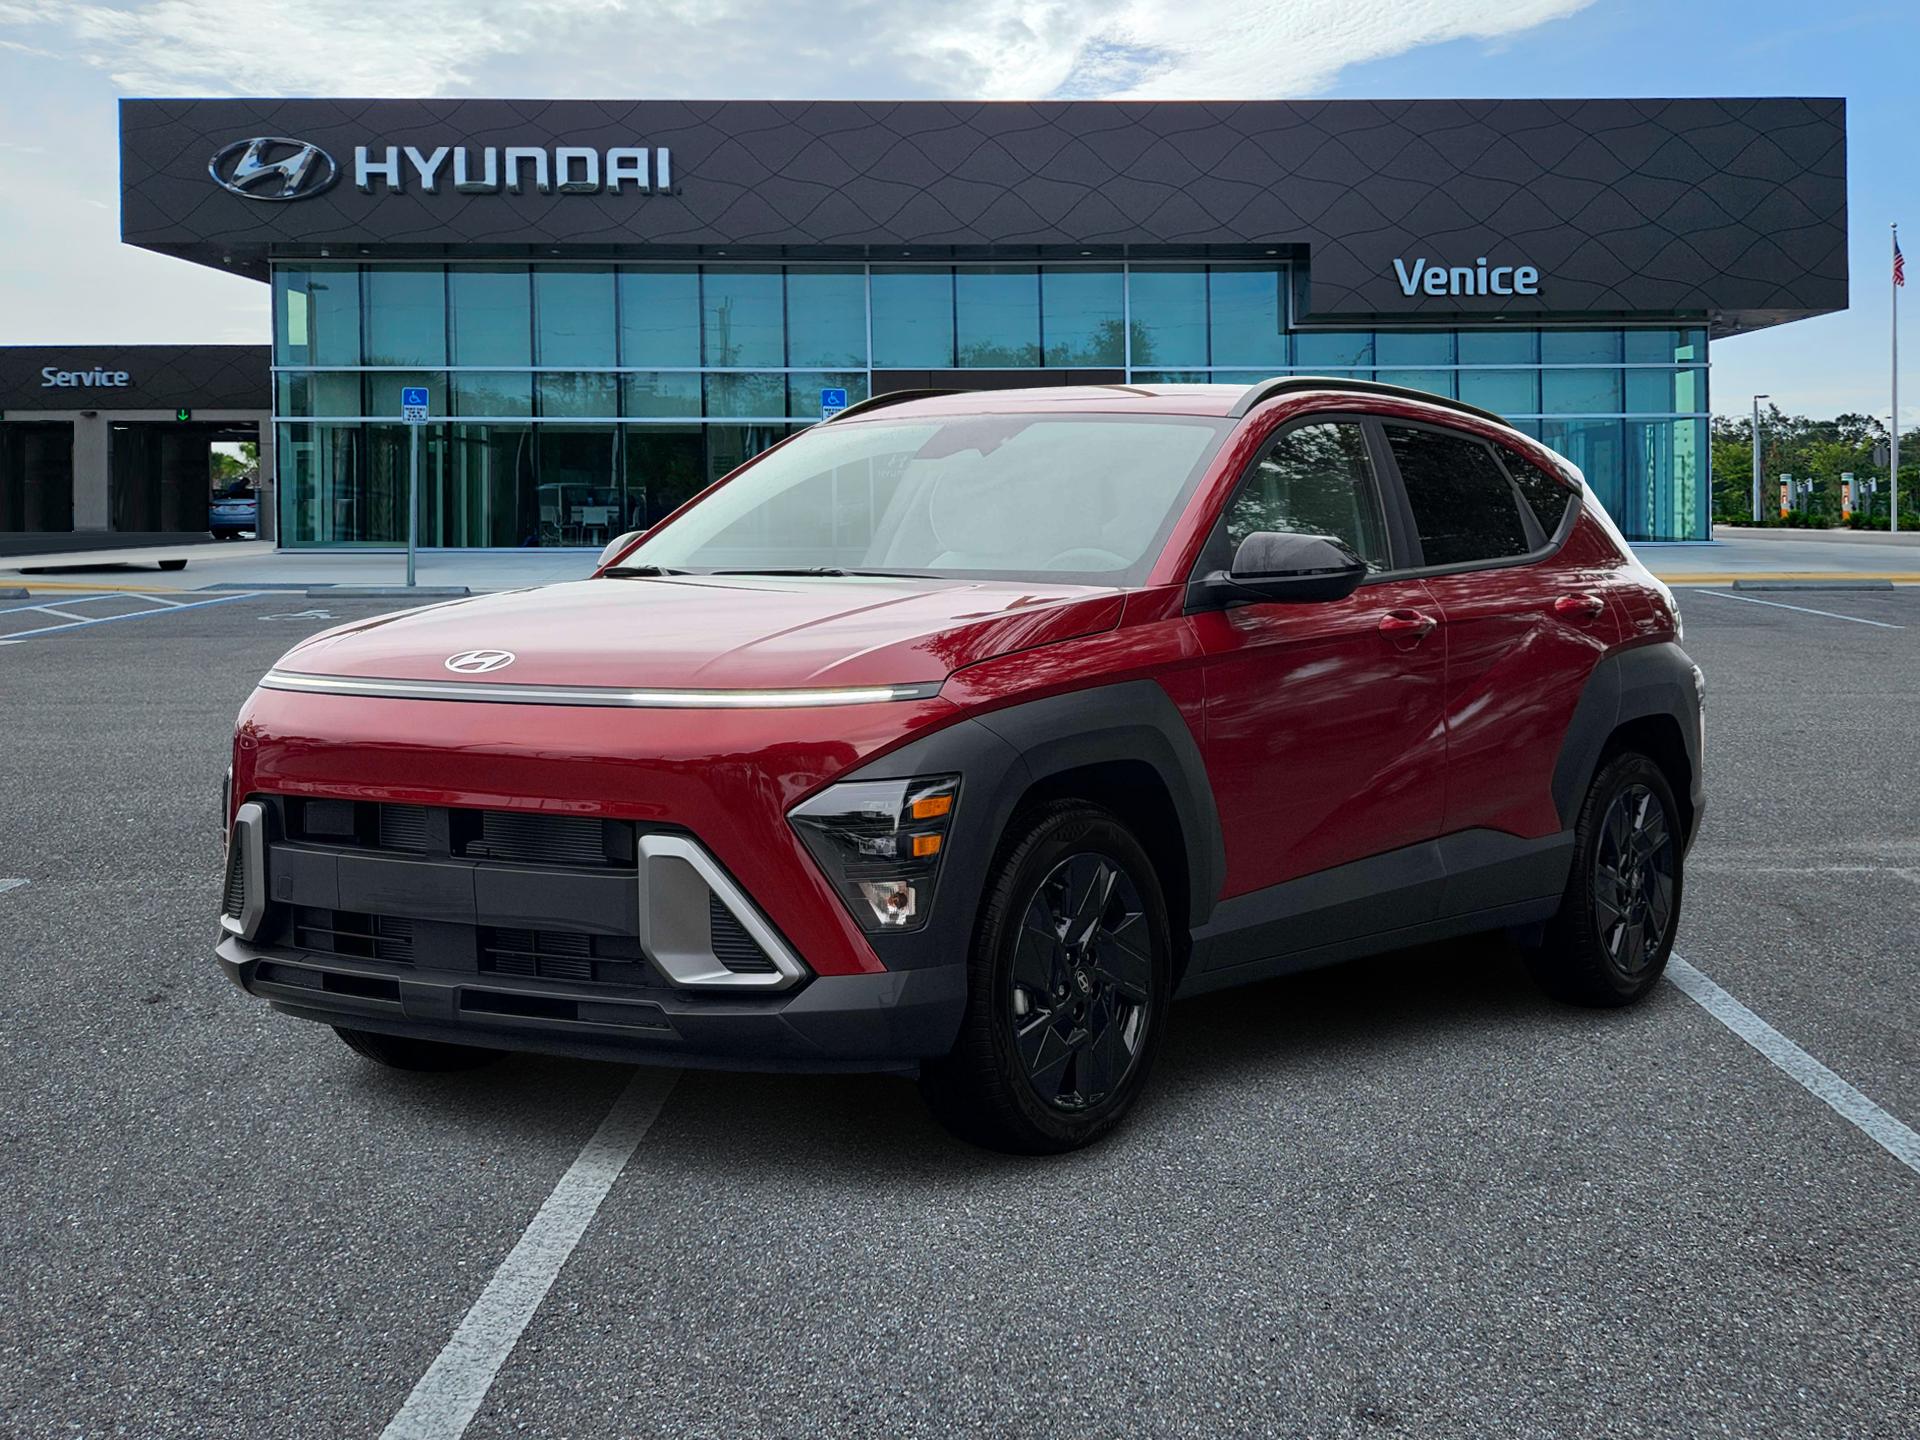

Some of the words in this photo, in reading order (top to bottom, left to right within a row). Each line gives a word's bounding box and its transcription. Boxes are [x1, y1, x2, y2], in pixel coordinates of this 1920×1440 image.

[354, 146, 671, 194] HYUNDAI
[1392, 256, 1539, 296] Venice
[40, 366, 130, 387] Service
